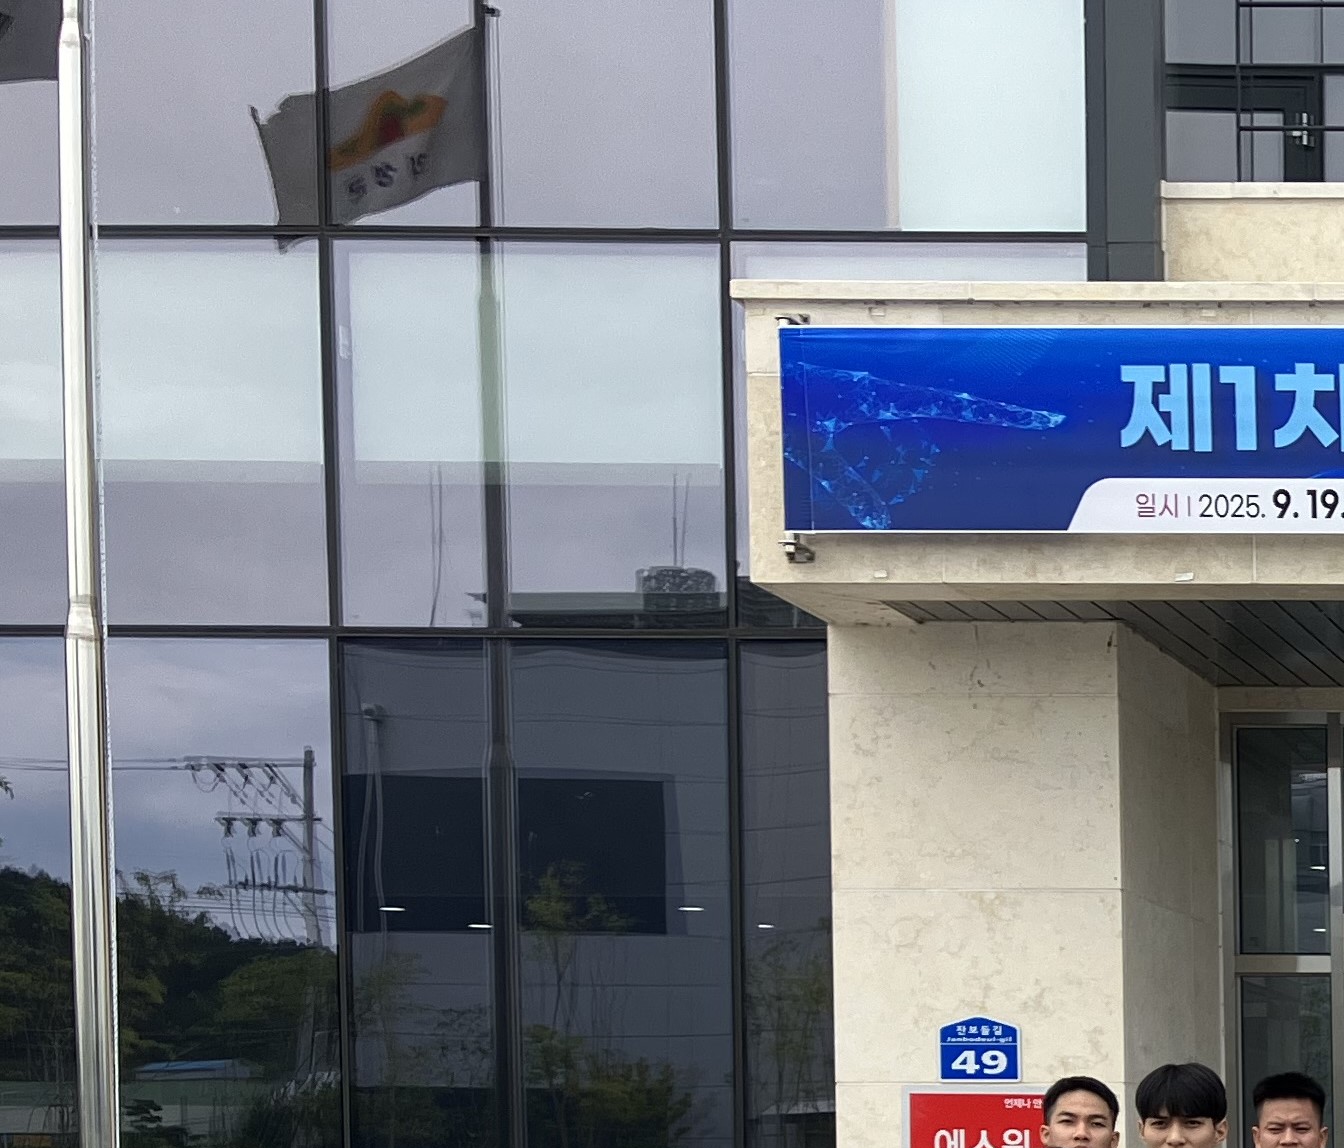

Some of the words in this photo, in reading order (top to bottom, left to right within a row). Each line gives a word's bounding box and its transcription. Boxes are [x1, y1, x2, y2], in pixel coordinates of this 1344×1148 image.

[1136, 493, 1178, 518] 일시
[1198, 494, 1266, 518] 2025.
[951, 1050, 1008, 1074] 49
